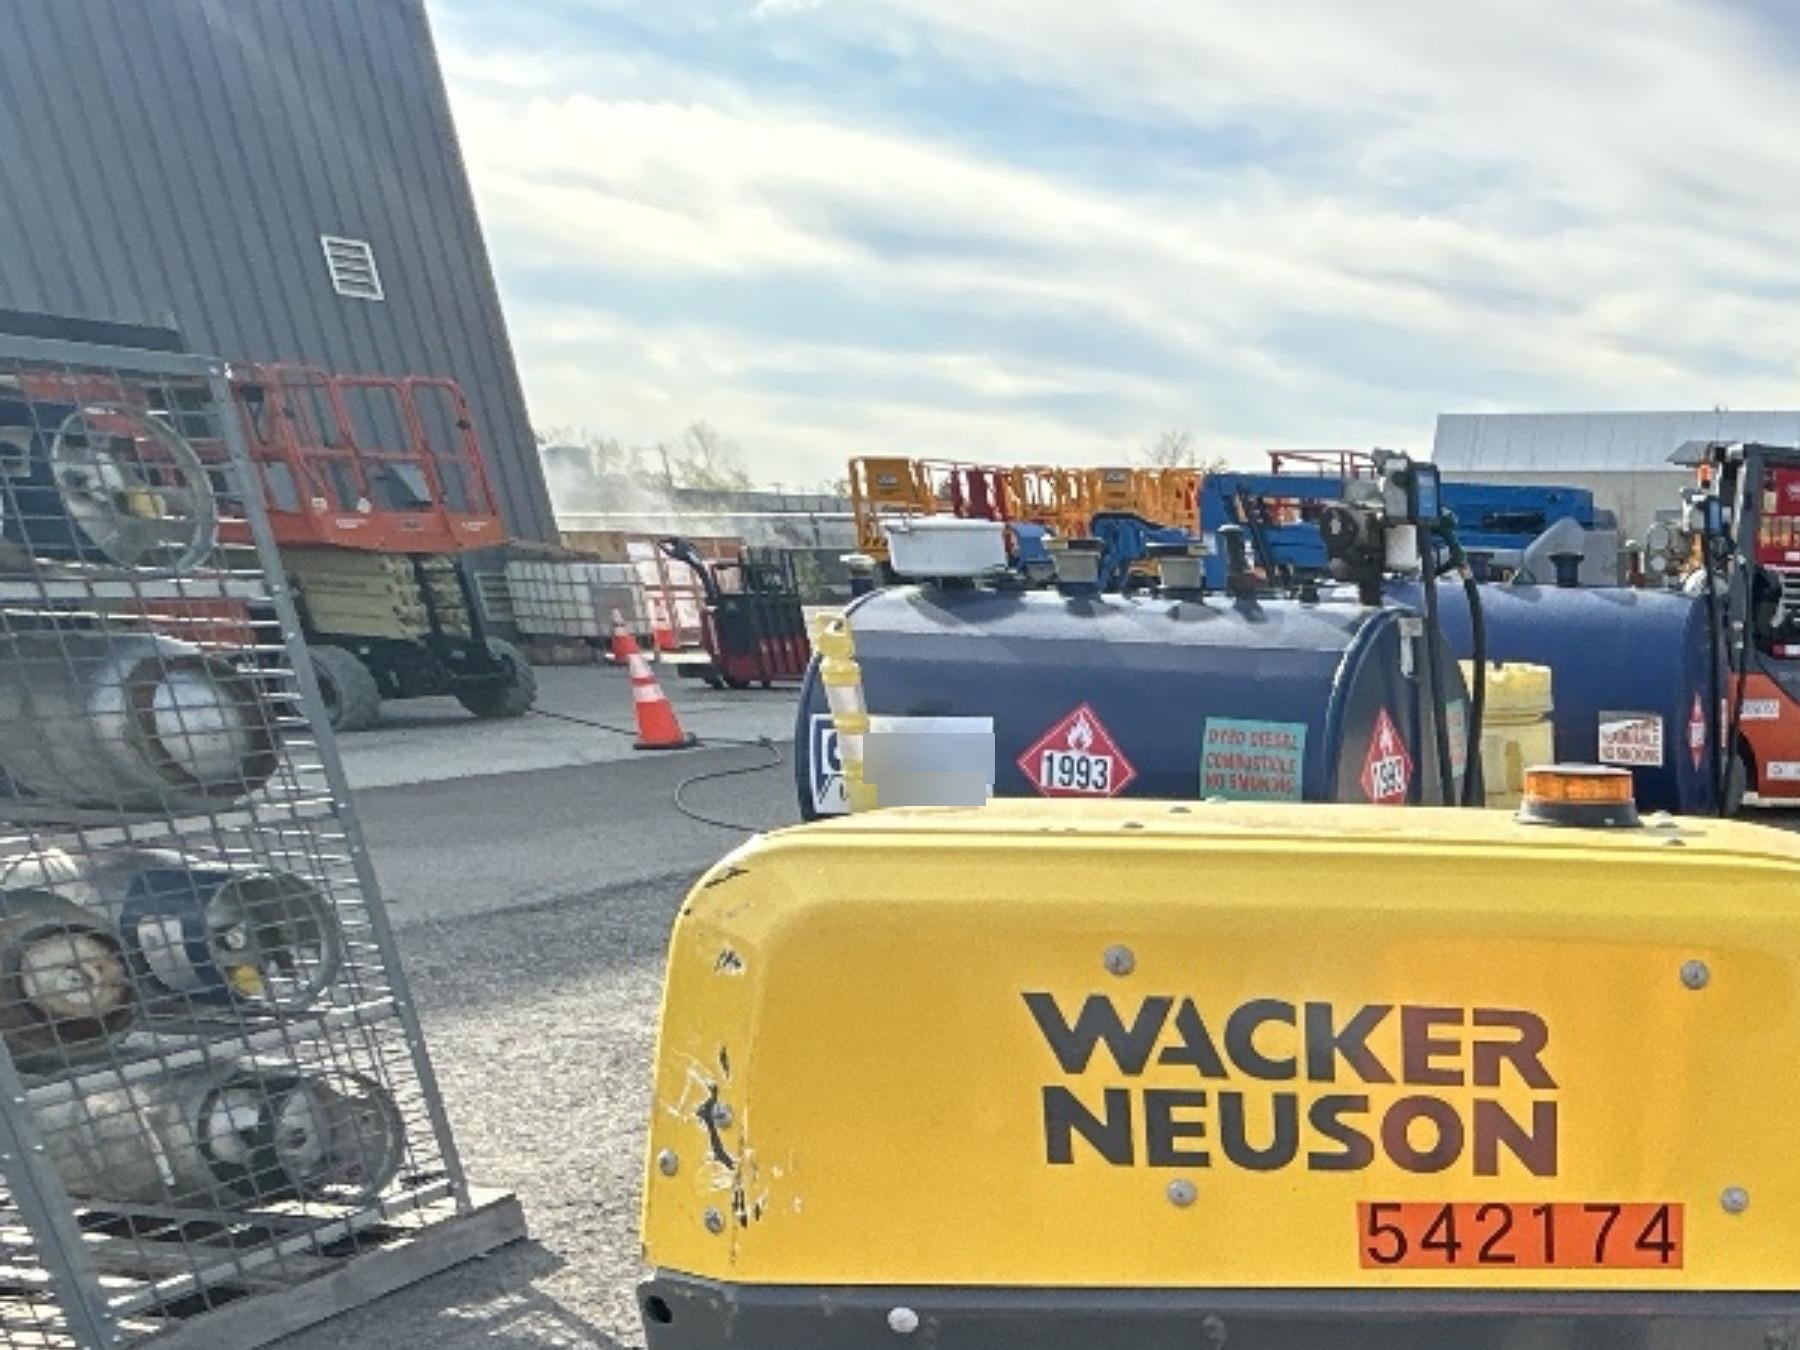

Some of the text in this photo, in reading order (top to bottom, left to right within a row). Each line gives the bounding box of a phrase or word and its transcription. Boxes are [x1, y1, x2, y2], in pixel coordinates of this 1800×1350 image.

[1045, 752, 1108, 790] 1993
[1021, 992, 1558, 1089] WACKER
[1041, 1085, 1558, 1177] NEUSON
[1367, 1202, 1675, 1265] 542174
